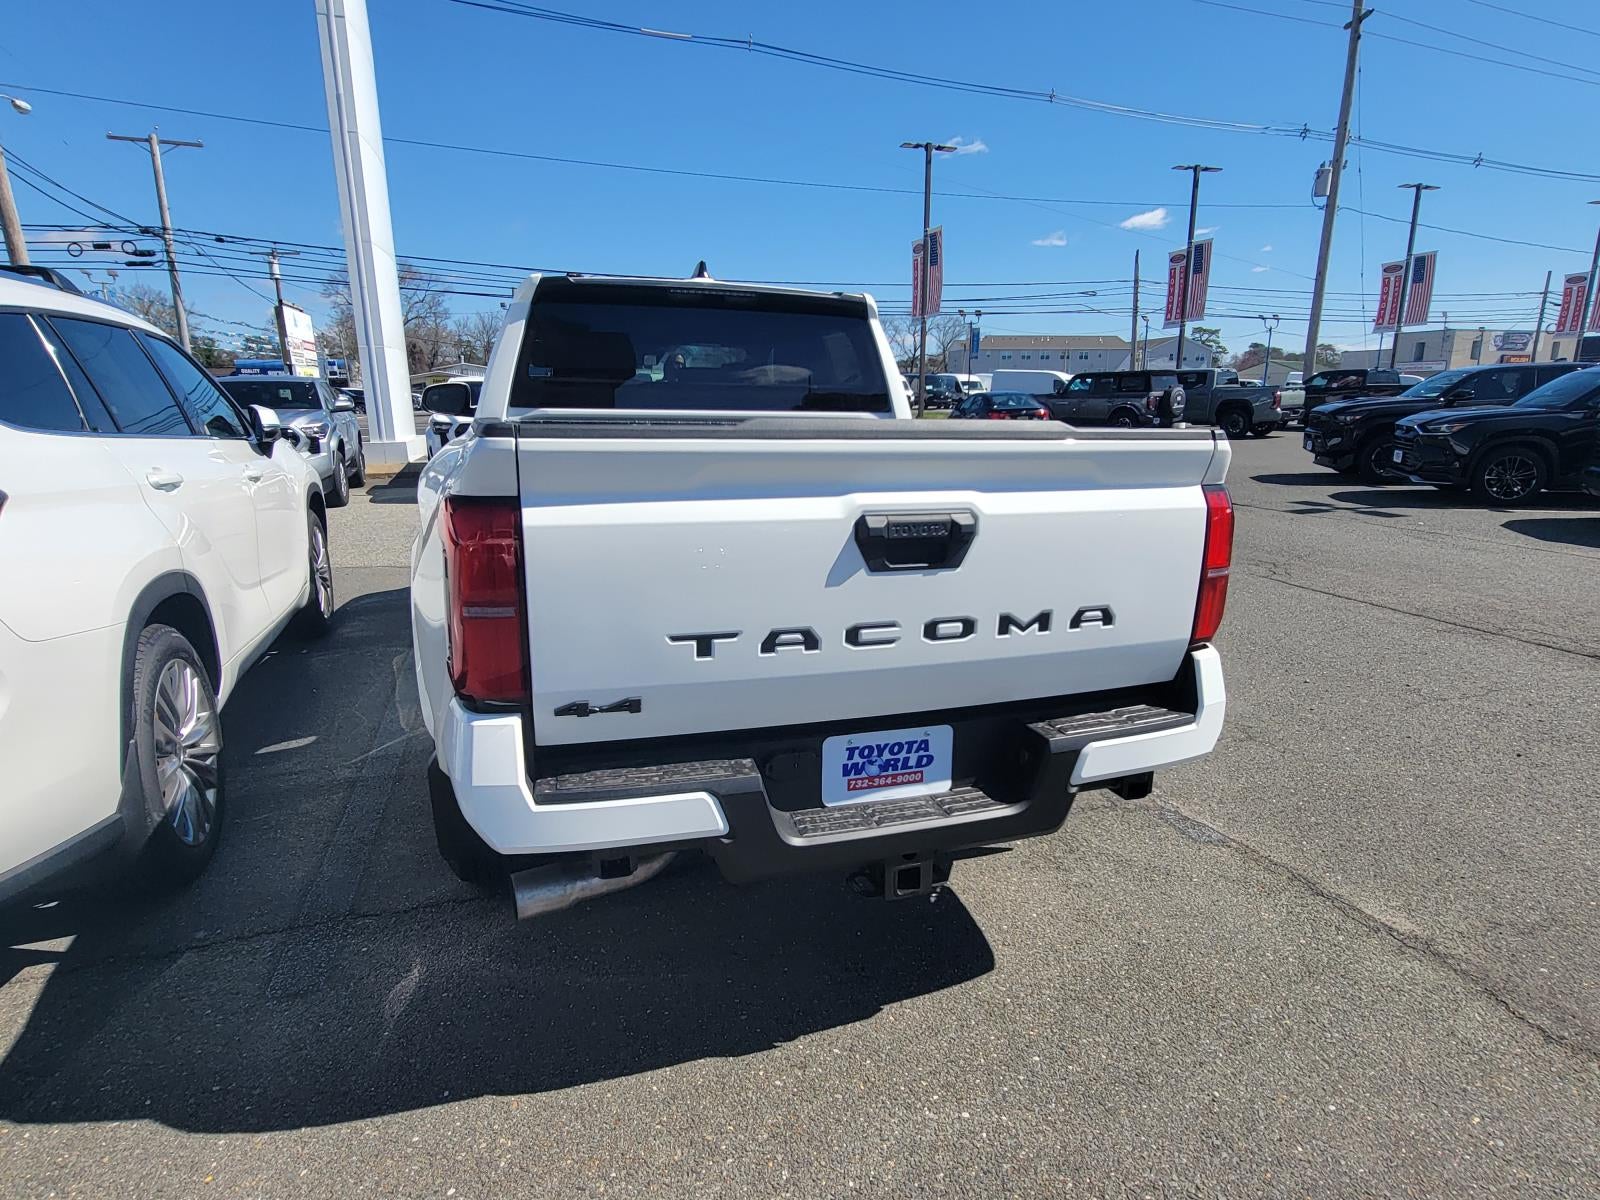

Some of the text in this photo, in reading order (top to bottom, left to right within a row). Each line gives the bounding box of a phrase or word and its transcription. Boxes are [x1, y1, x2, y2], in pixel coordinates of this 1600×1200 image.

[1166, 269, 1175, 320] TOYOTA
[1377, 278, 1389, 324] TOYOTA
[1558, 289, 1571, 331] TOYOTA
[891, 525, 949, 536] TOYOTA
[665, 604, 1116, 661] TACOMA
[845, 739, 930, 761] TOYOTA
[849, 773, 922, 789] 732-364-9000
